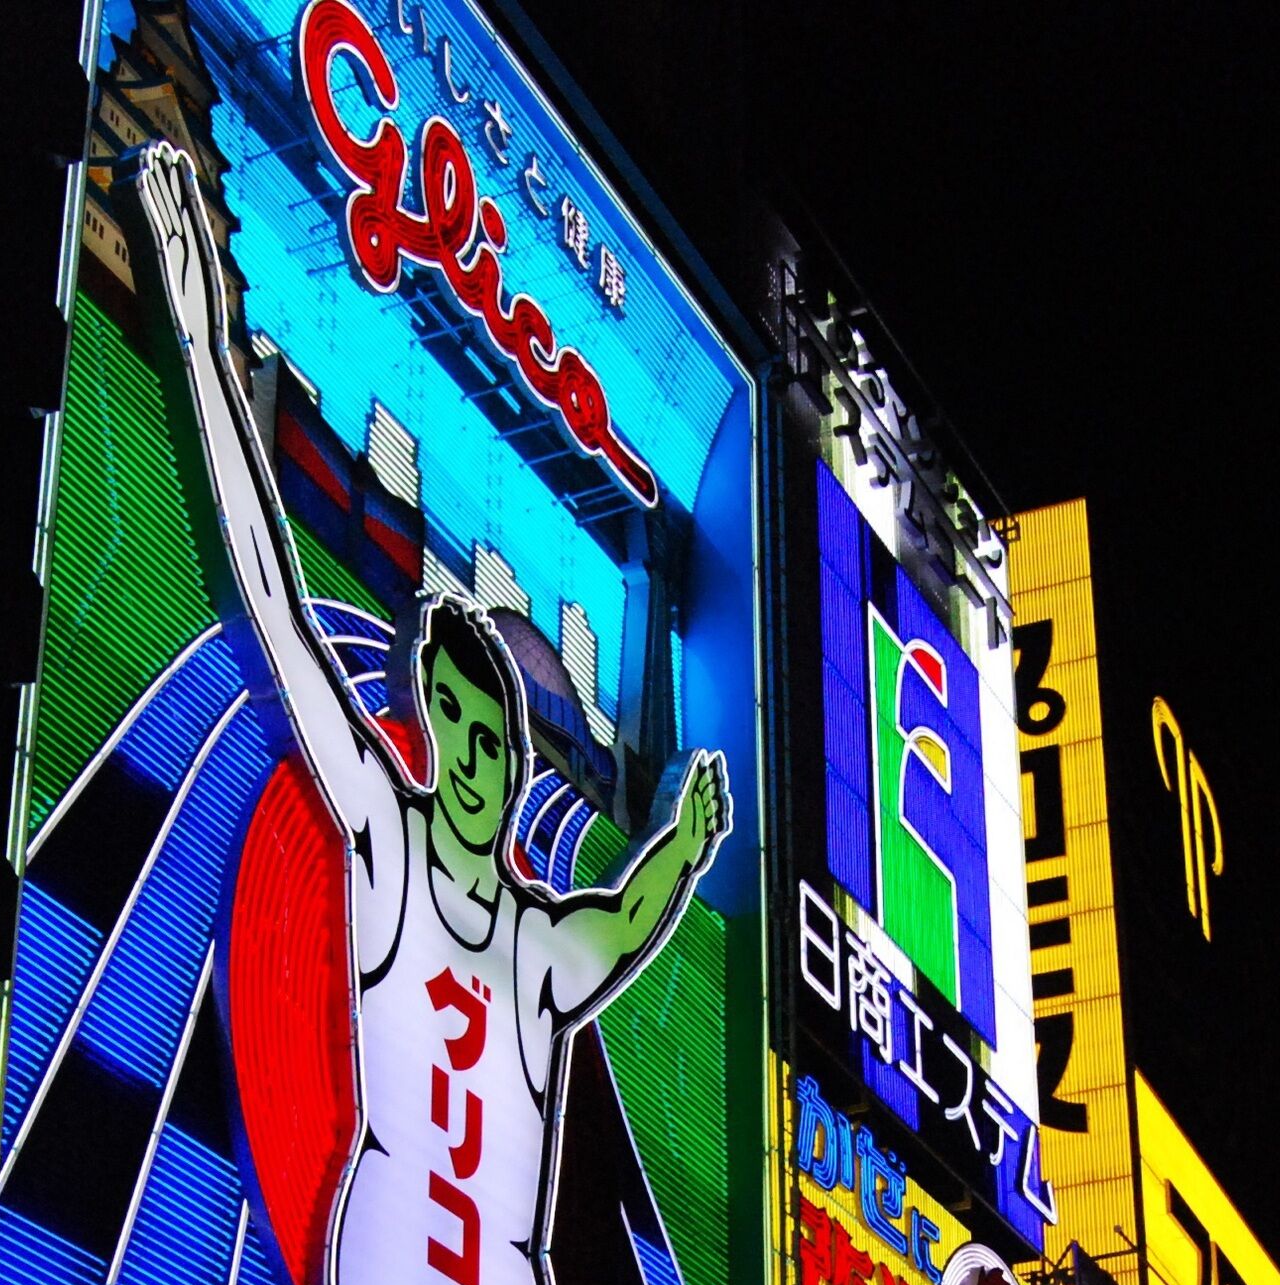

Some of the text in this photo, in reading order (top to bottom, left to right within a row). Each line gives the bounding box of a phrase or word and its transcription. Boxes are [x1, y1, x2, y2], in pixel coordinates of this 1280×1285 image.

[300, 0, 658, 507] Glico
[799, 879, 1058, 1226] 日商エステム
